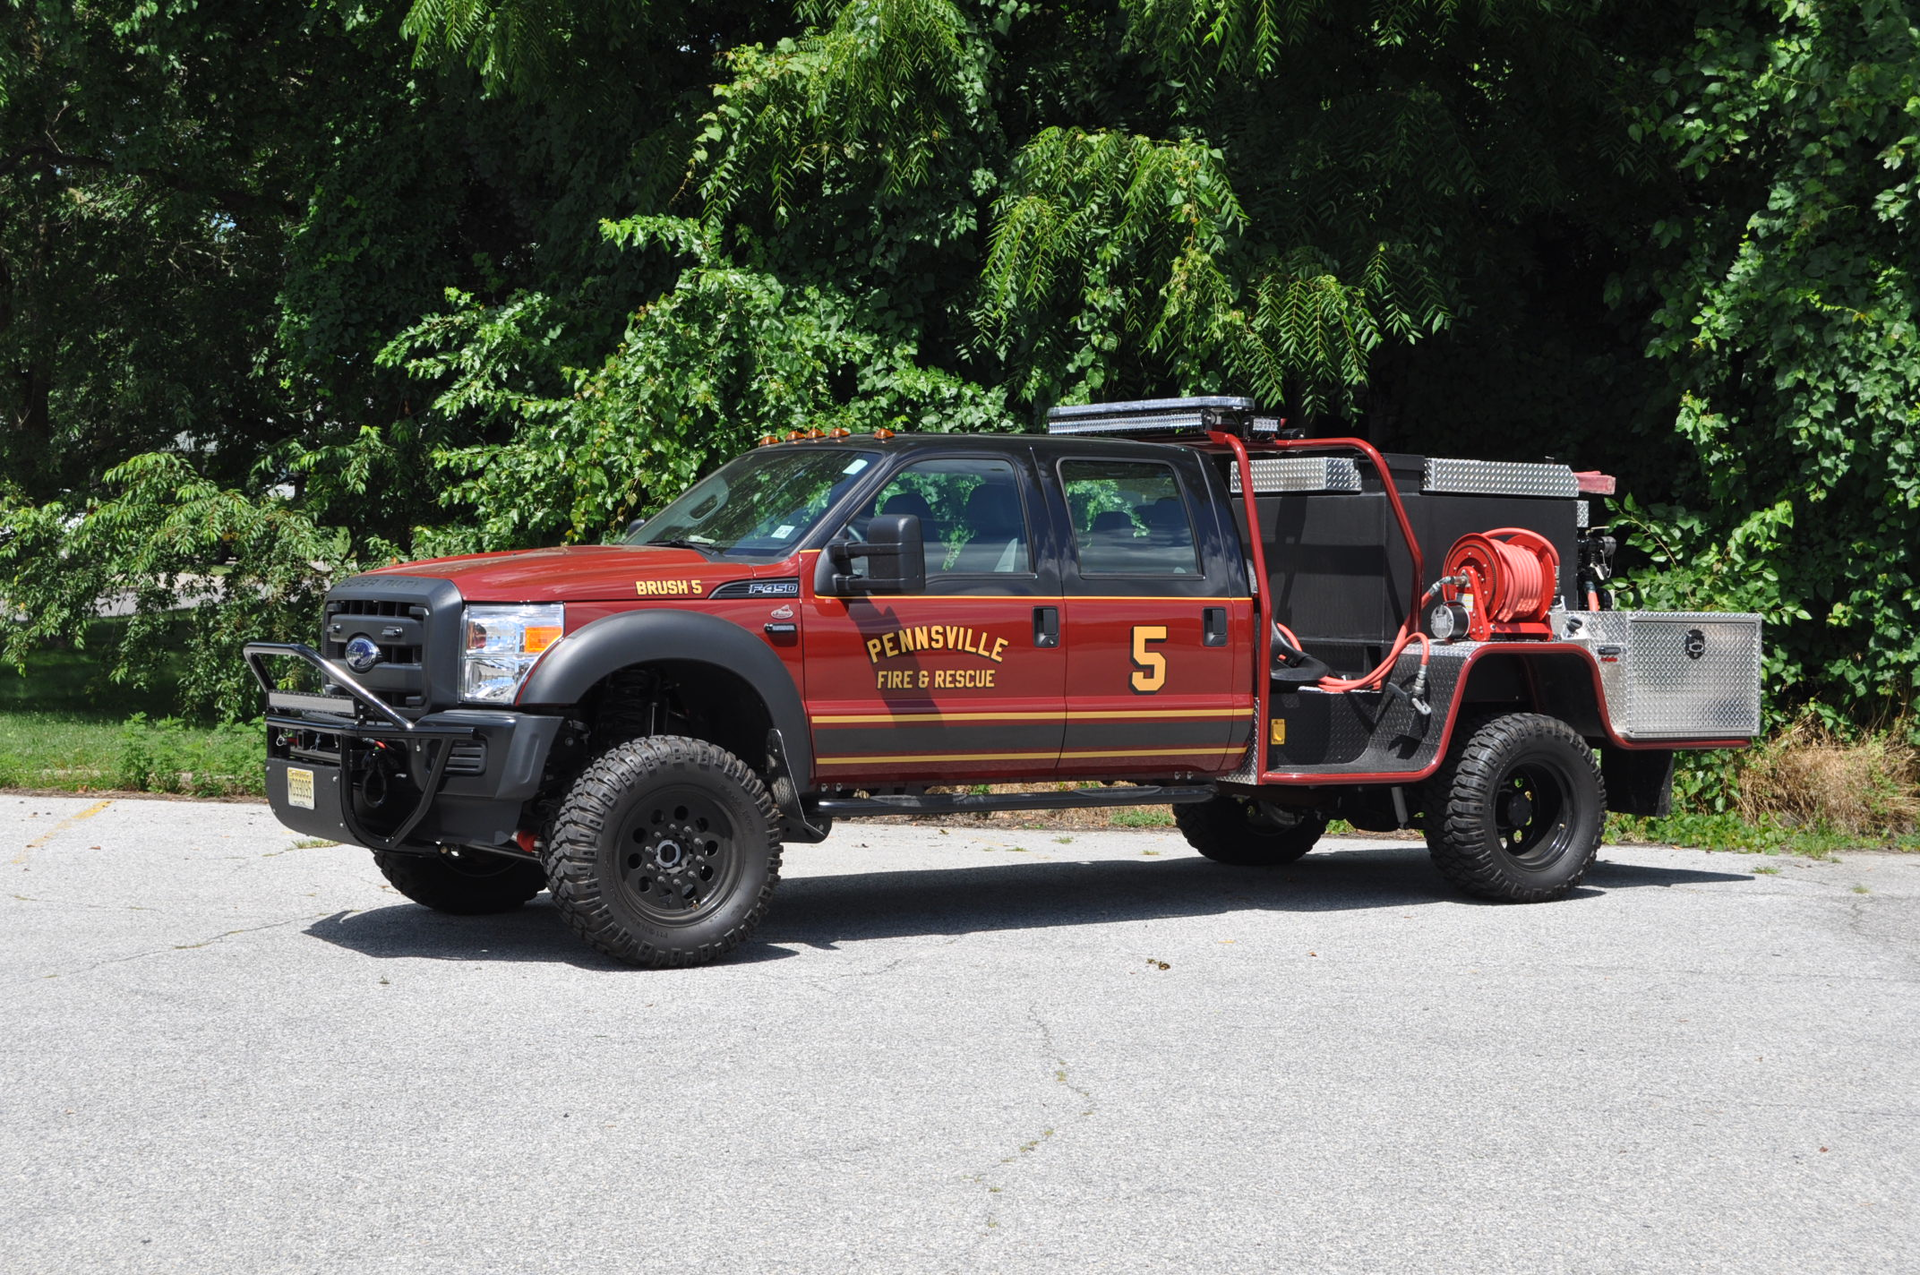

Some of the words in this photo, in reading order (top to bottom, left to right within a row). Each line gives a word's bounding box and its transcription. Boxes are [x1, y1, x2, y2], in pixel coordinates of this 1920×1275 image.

[341, 578, 381, 589] SUPER
[635, 580, 689, 595] BRUSH
[691, 579, 703, 594] 5
[749, 583, 798, 594] F-450
[866, 625, 1009, 664] PENNSVILLE
[1130, 625, 1168, 693] 5
[877, 670, 913, 689] FIRE
[918, 670, 930, 688] &
[934, 669, 996, 688] RESCUE
